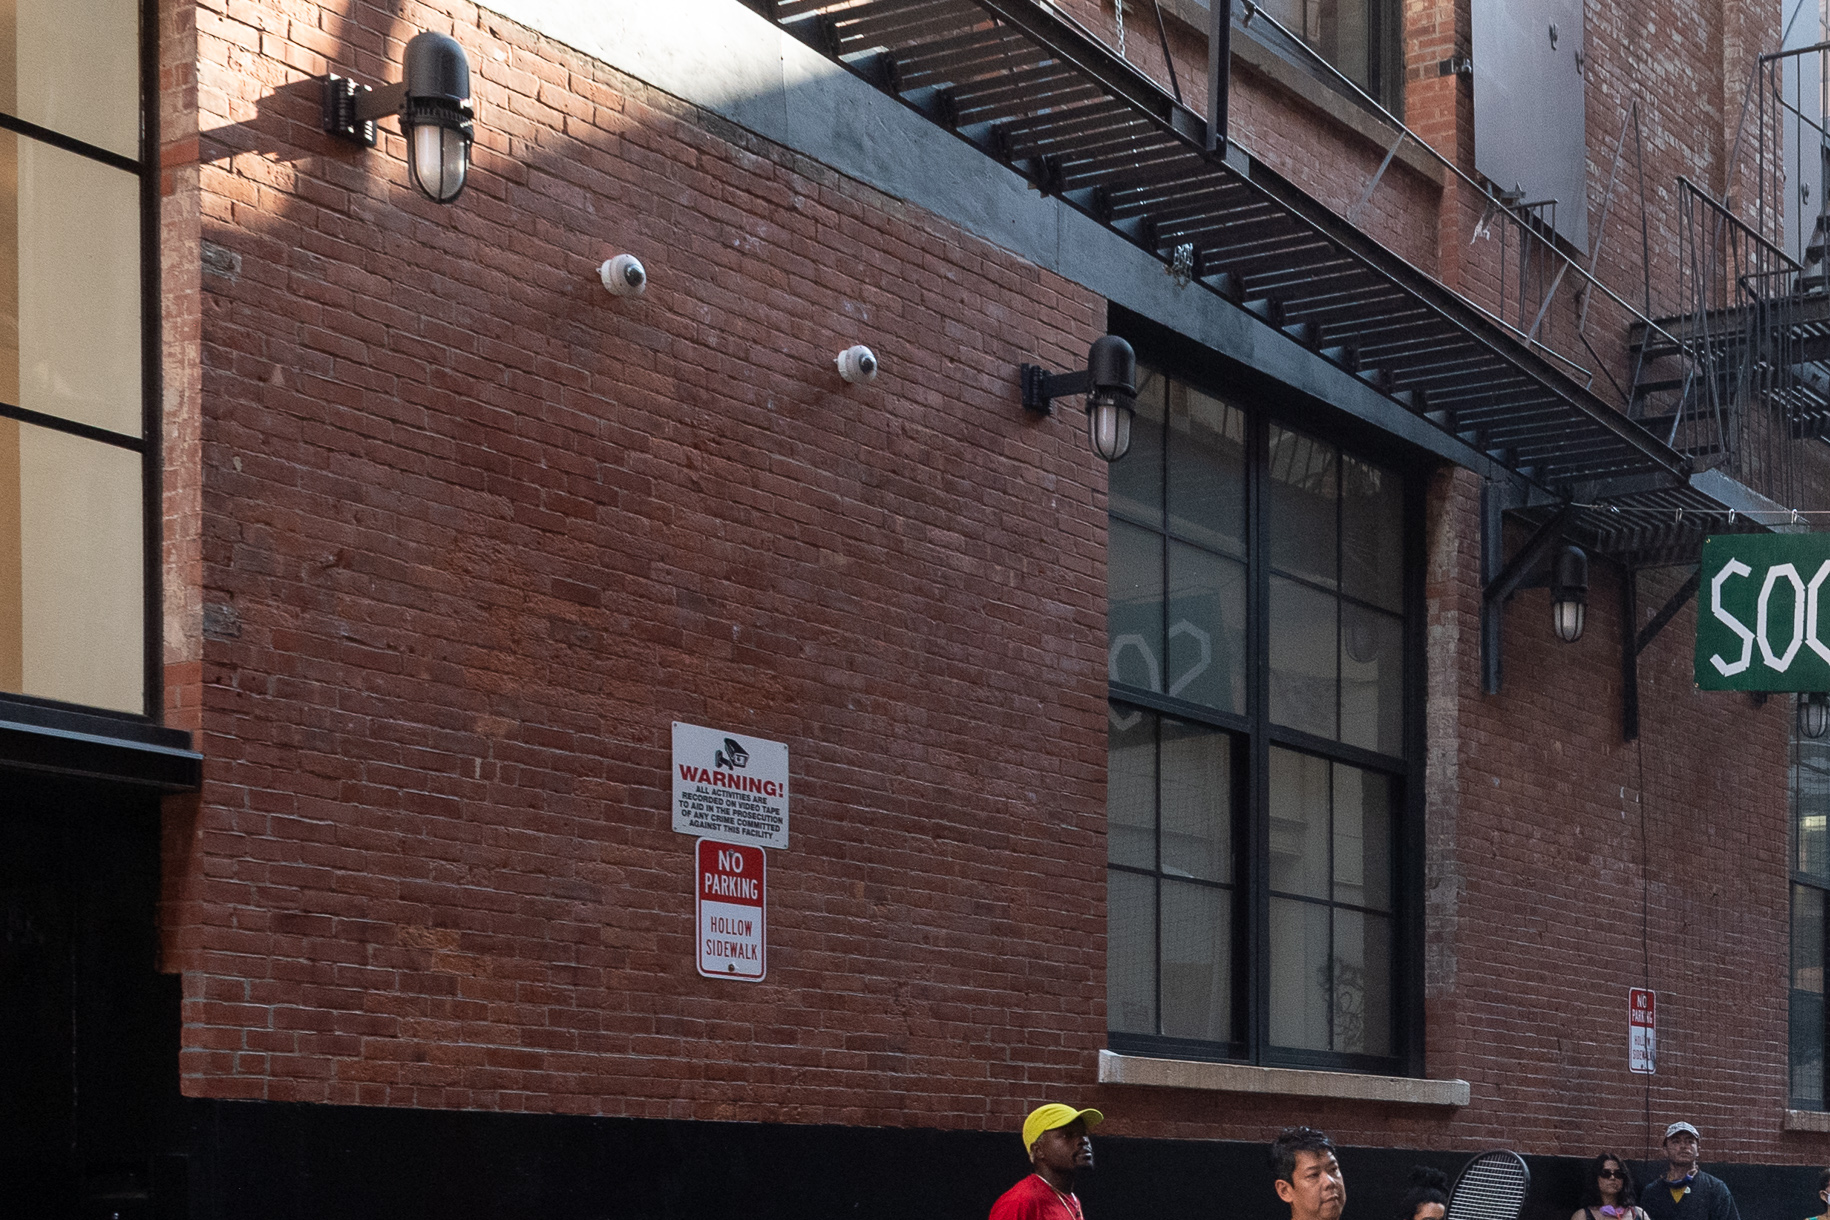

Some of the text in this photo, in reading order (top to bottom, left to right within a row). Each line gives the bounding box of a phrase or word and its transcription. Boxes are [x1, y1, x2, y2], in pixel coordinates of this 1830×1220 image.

[679, 764, 783, 798] WARNING!
[682, 791, 780, 816] RECORDED ON VIDEO TAPE
[696, 785, 767, 805] ALL ACTIVITIES ARE
[679, 799, 783, 825] TO AID IN THE PROSECUTION
[681, 809, 780, 833] OF ANY CRIME COMMITTED
[689, 819, 773, 840] AGAINST THIS FACILITY
[718, 850, 743, 873] NO
[704, 872, 758, 900] PARKING
[710, 916, 752, 937] HOLLOW
[706, 939, 757, 961] SIDEWALK
[1637, 993, 1648, 1009] NO
[1632, 1008, 1653, 1024] PARKNG
